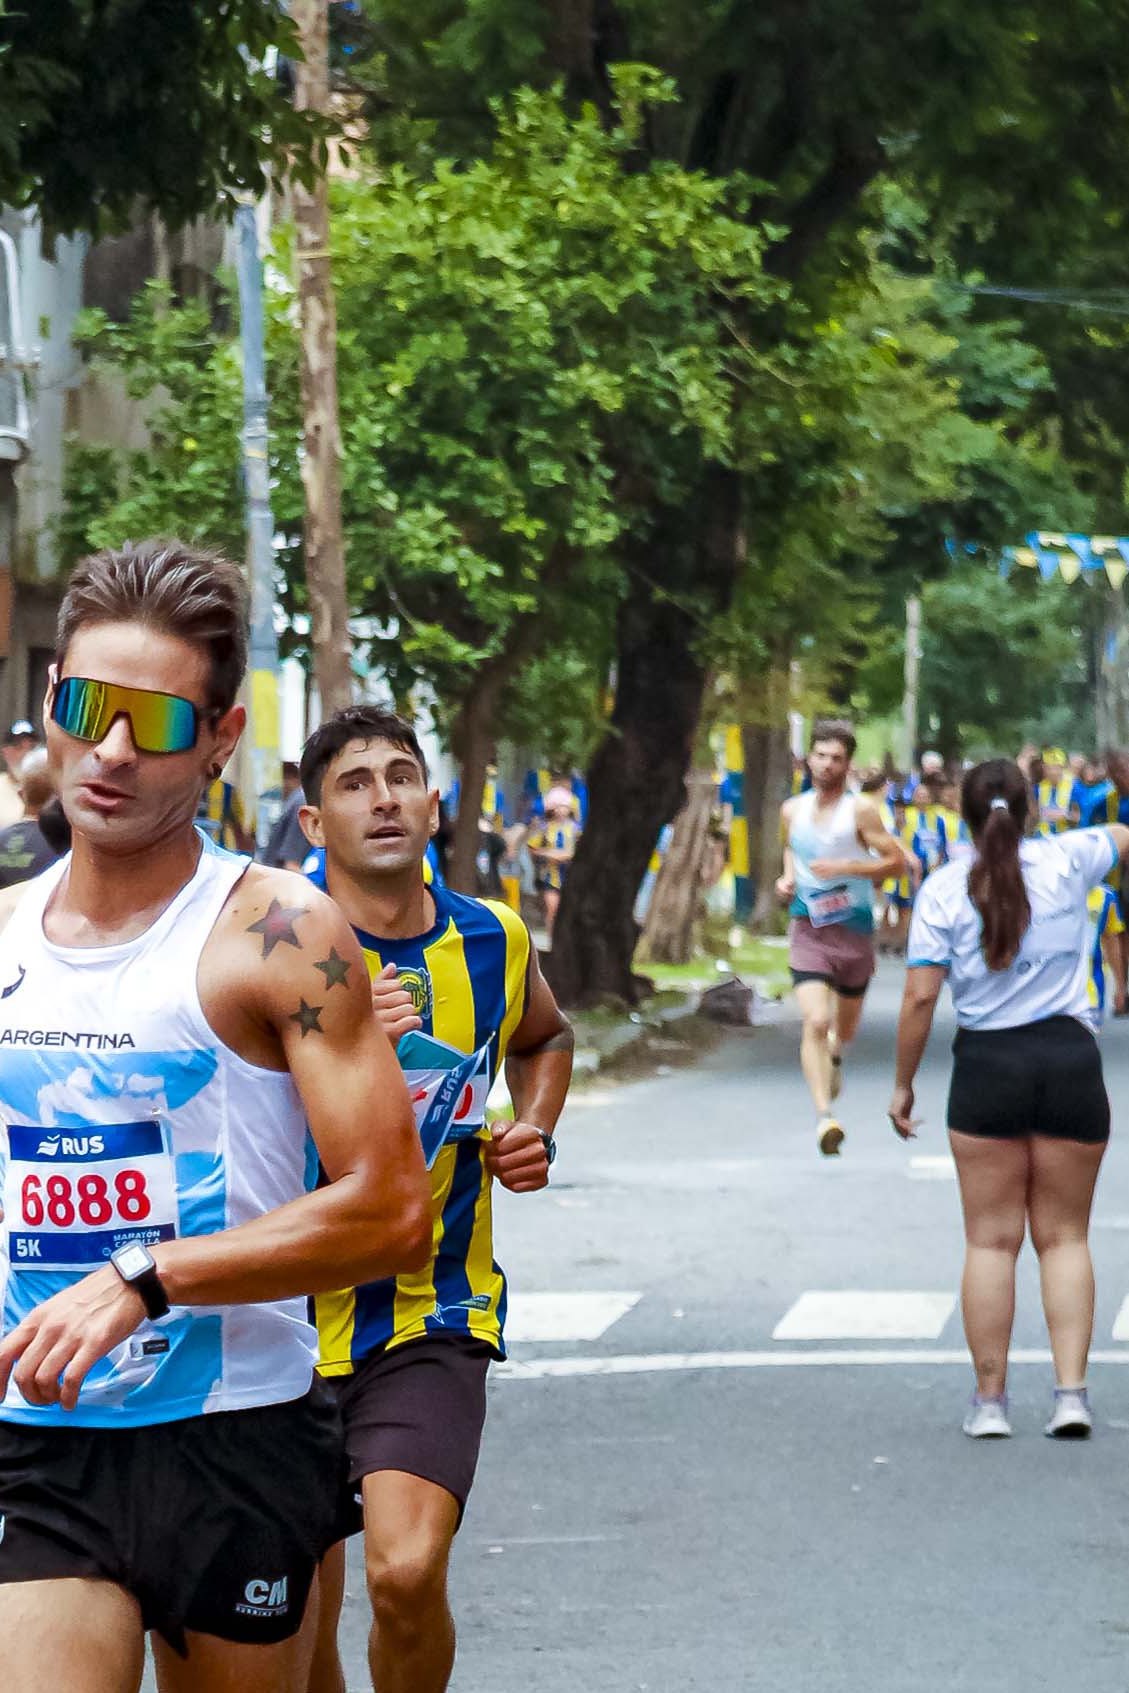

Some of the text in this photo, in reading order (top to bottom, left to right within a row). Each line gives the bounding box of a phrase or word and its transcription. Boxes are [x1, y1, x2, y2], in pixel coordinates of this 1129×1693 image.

[0, 1028, 136, 1050] ARGENTINA
[61, 1135, 105, 1156] RUS
[21, 1169, 151, 1228] 6888
[113, 1229, 161, 1242] MARATÓN
[16, 1238, 41, 1257] 5K
[245, 1576, 287, 1606] CM
